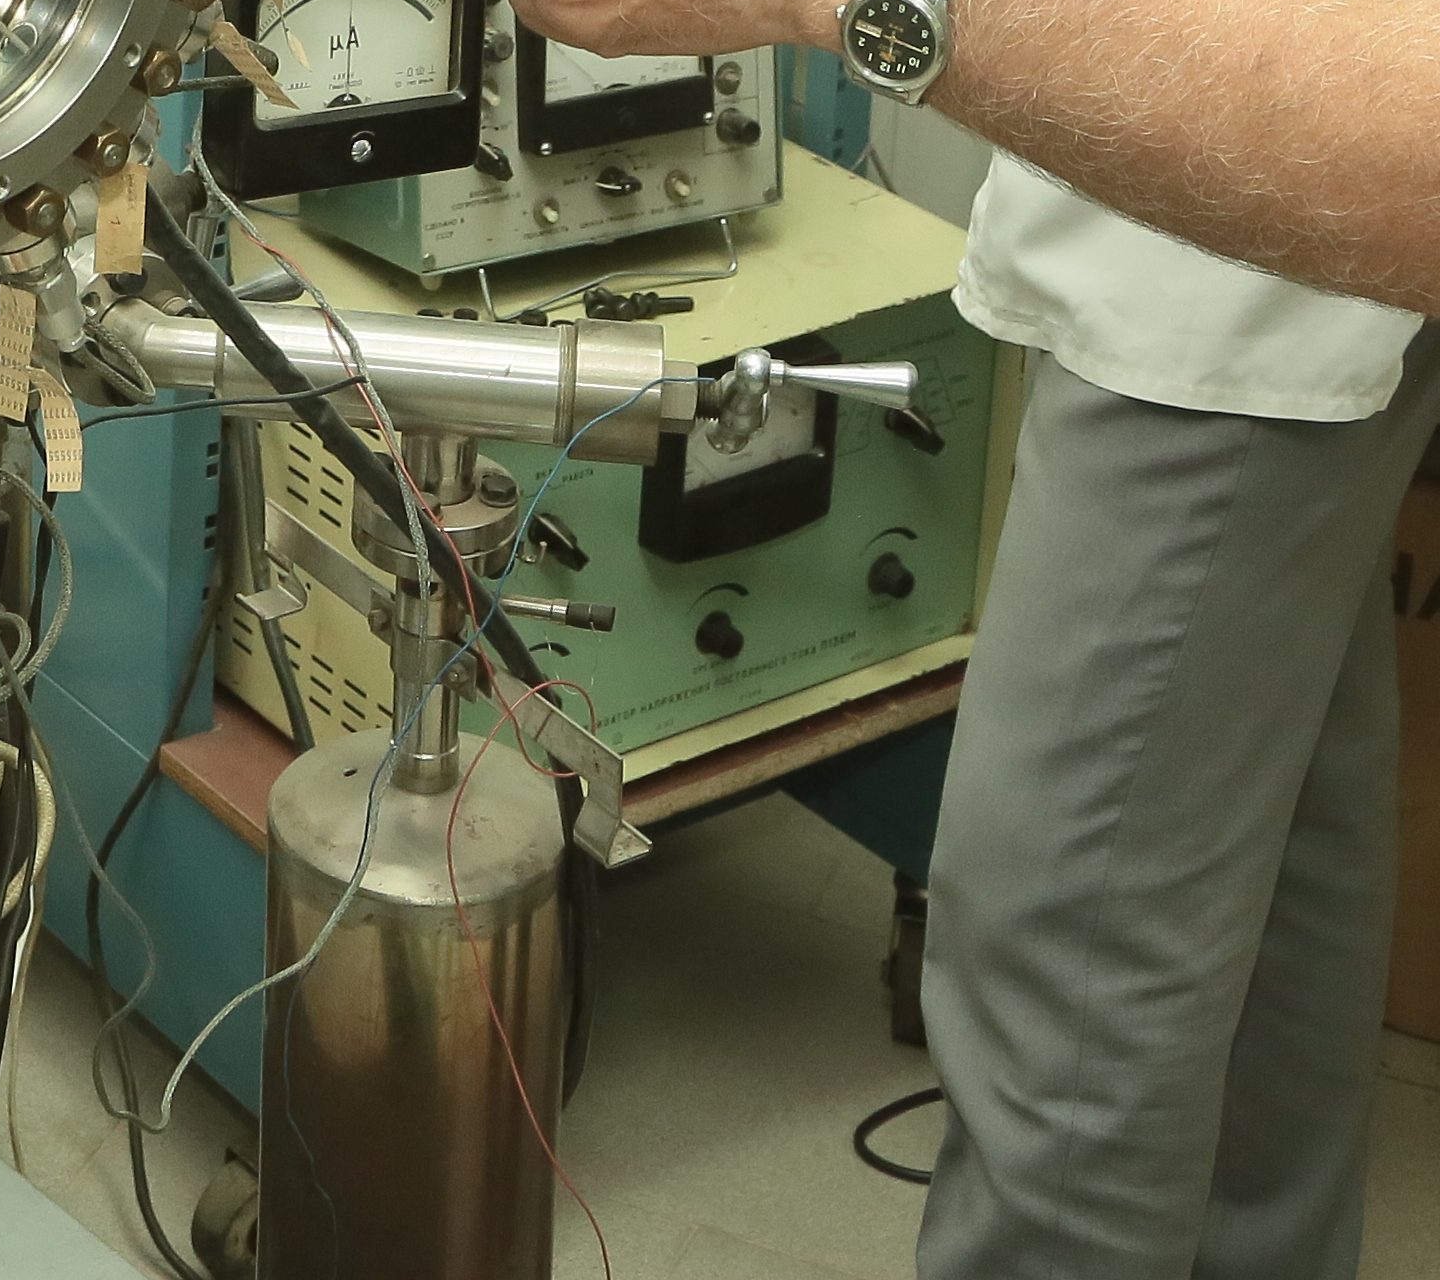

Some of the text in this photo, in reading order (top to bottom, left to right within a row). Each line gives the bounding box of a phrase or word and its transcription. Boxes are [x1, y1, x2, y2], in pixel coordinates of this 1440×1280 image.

[921, 29, 929, 39] 8
[858, 37, 866, 47] 2
[879, 61, 890, 73] 12
[908, 57, 920, 68] 10
[896, 63, 906, 74] 11
